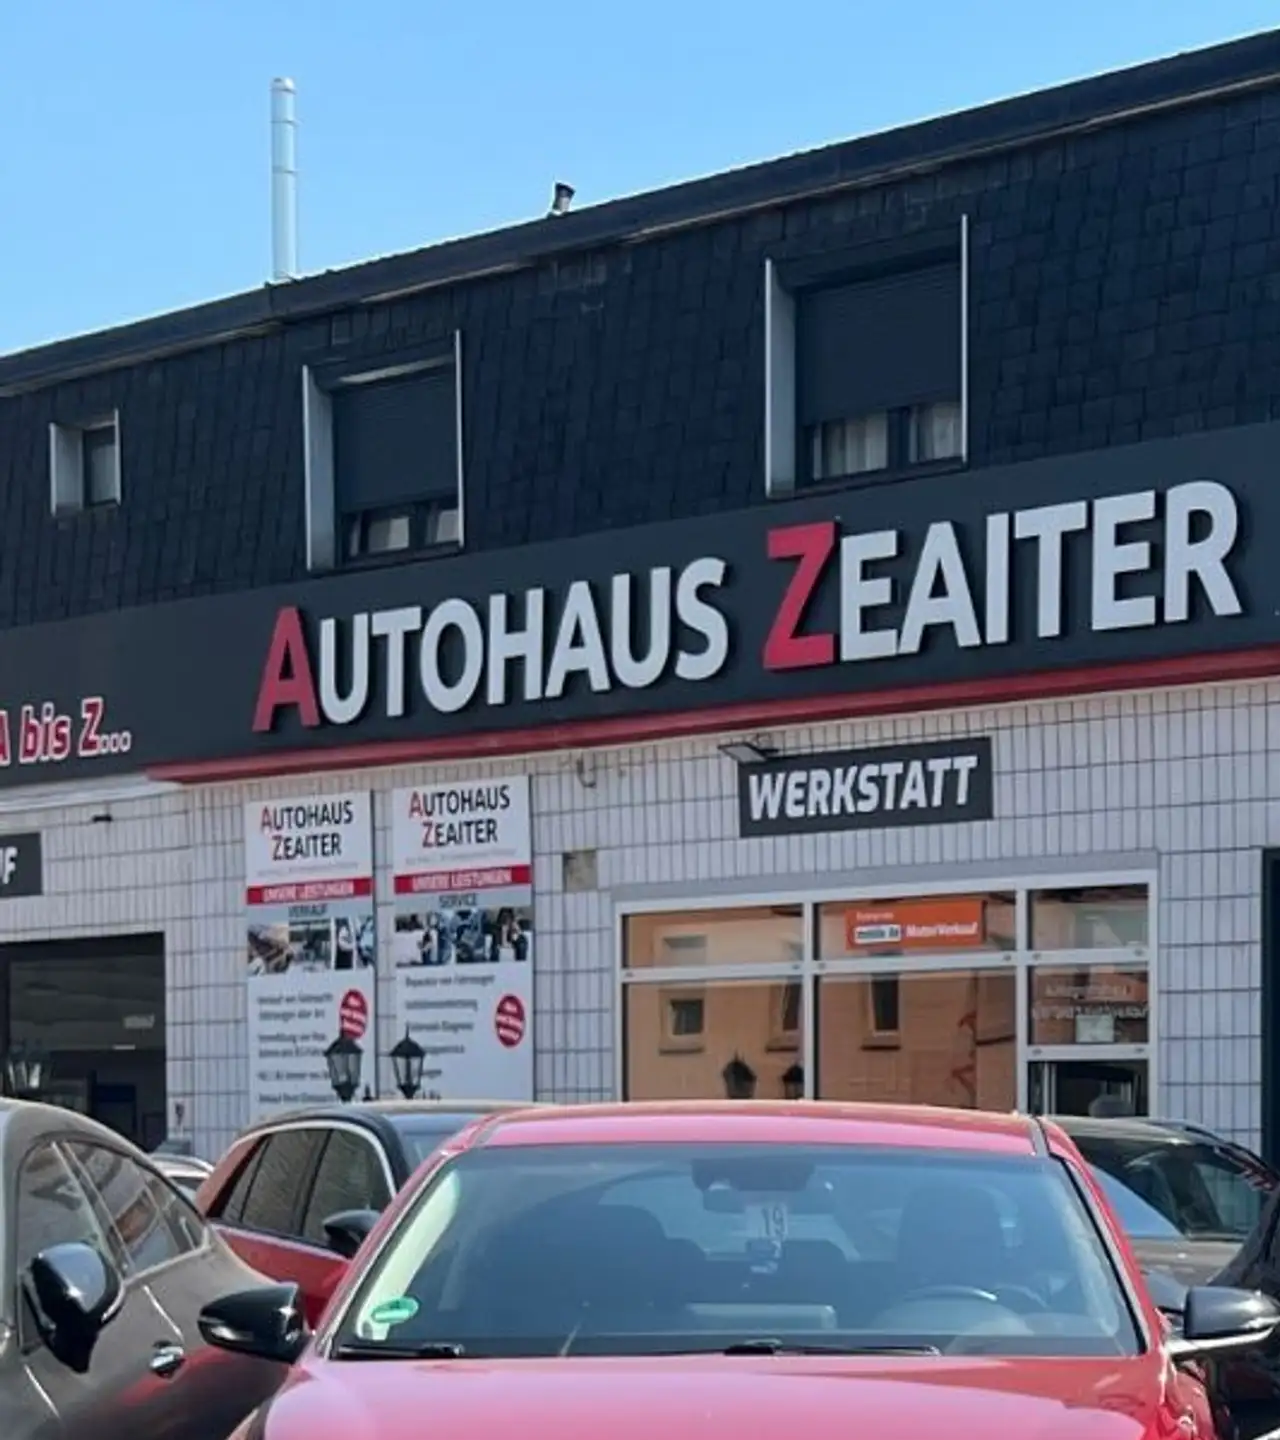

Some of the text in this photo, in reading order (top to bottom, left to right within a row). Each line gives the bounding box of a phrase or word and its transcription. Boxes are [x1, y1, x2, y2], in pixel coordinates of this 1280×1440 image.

[252, 479, 1244, 733] AUTOHAUS ZEAITER
[19, 702, 71, 763] bis
[409, 785, 510, 818] AUTOHAUS
[749, 755, 978, 821] WERKSTATT
[260, 801, 354, 834] AUTOHAUS
[422, 819, 498, 848] ZEAITER
[272, 833, 341, 861] ZEAITER
